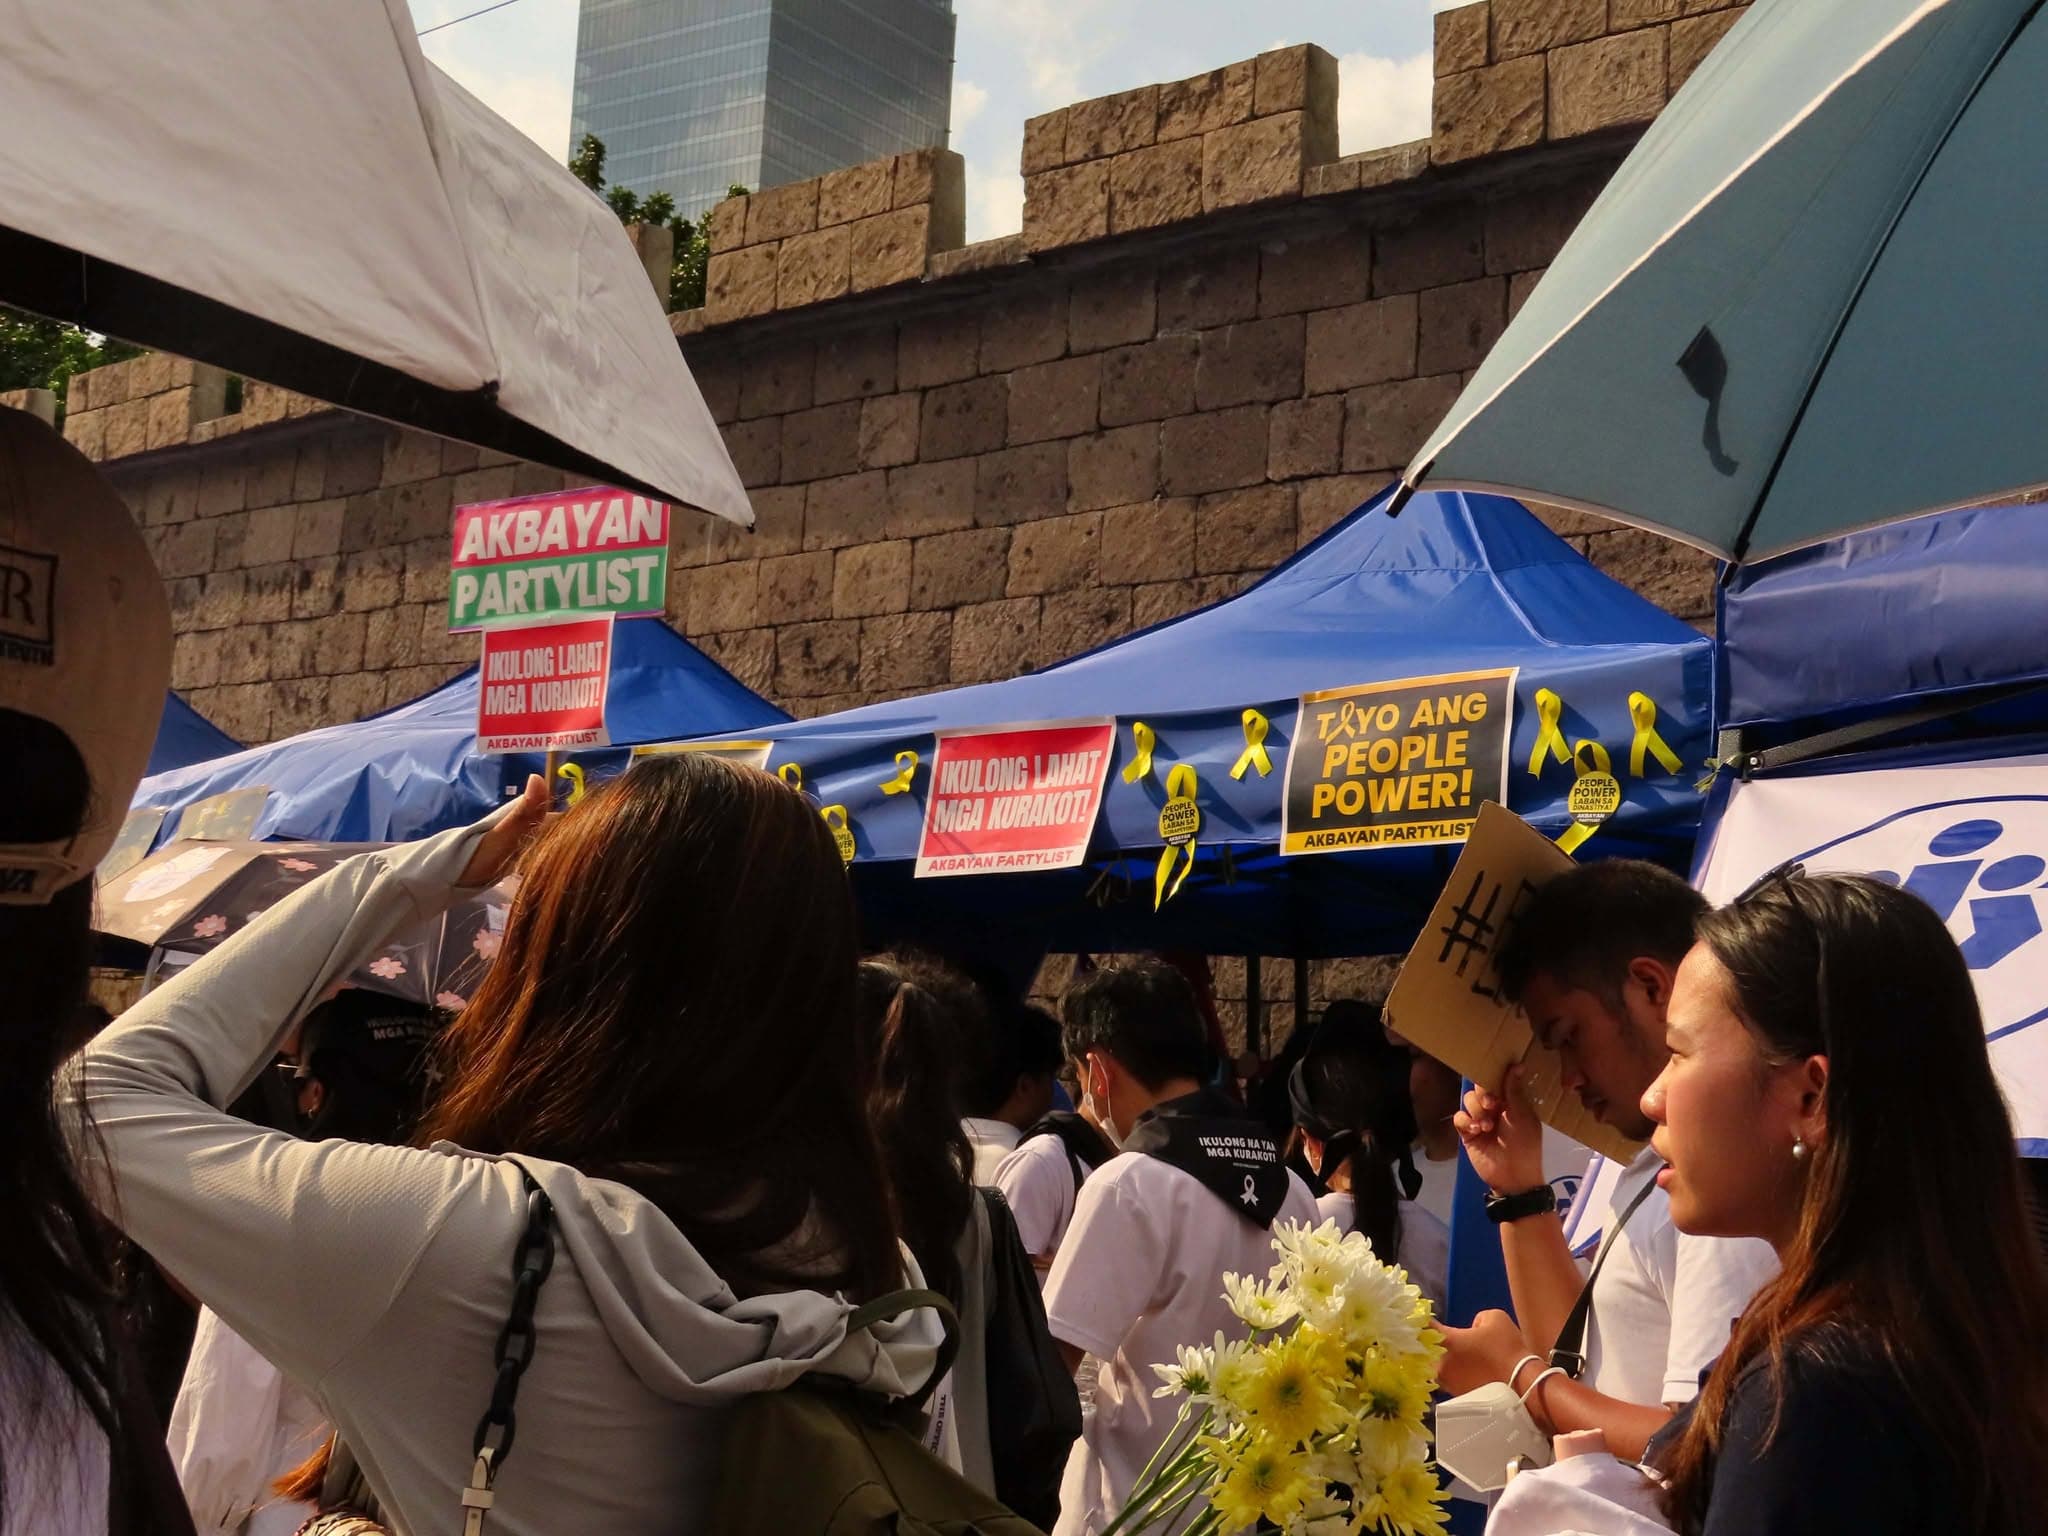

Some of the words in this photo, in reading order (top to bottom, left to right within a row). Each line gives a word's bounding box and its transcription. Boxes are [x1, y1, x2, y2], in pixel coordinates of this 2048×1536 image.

[456, 496, 662, 562] AKBAYAN
[454, 555, 660, 619] PARTYLIST
[487, 646, 554, 681] IKULONG
[558, 641, 604, 676] LAHAT
[485, 684, 526, 715] MGA
[531, 677, 601, 713] KURAKOT!
[1409, 692, 1487, 728] ANG
[487, 737, 543, 749] AKBAYAN
[545, 731, 598, 746] PARTYLIST
[1322, 730, 1469, 778] PEOPLE
[940, 757, 1028, 793] IKULONG
[1033, 751, 1101, 788] LAHAT
[1579, 779, 1614, 787] PEOPLE
[1164, 801, 1192, 812] PEOPLE
[1312, 768, 1473, 818] POWER!
[1574, 787, 1617, 798] POWER
[933, 798, 985, 833] MGA
[986, 789, 1092, 831] KURAKOT!
[1162, 809, 1196, 823] POWER
[1304, 829, 1380, 848] AKBAYAN
[1383, 822, 1475, 843] PARTYLIST
[928, 856, 994, 872] AKBAYAN
[995, 850, 1074, 867] PARTYLIST
[1199, 1136, 1246, 1148] IKULONG
[1247, 1138, 1260, 1149] NA
[1206, 1147, 1232, 1158] MGA
[1233, 1148, 1277, 1163] KURAKOT!
